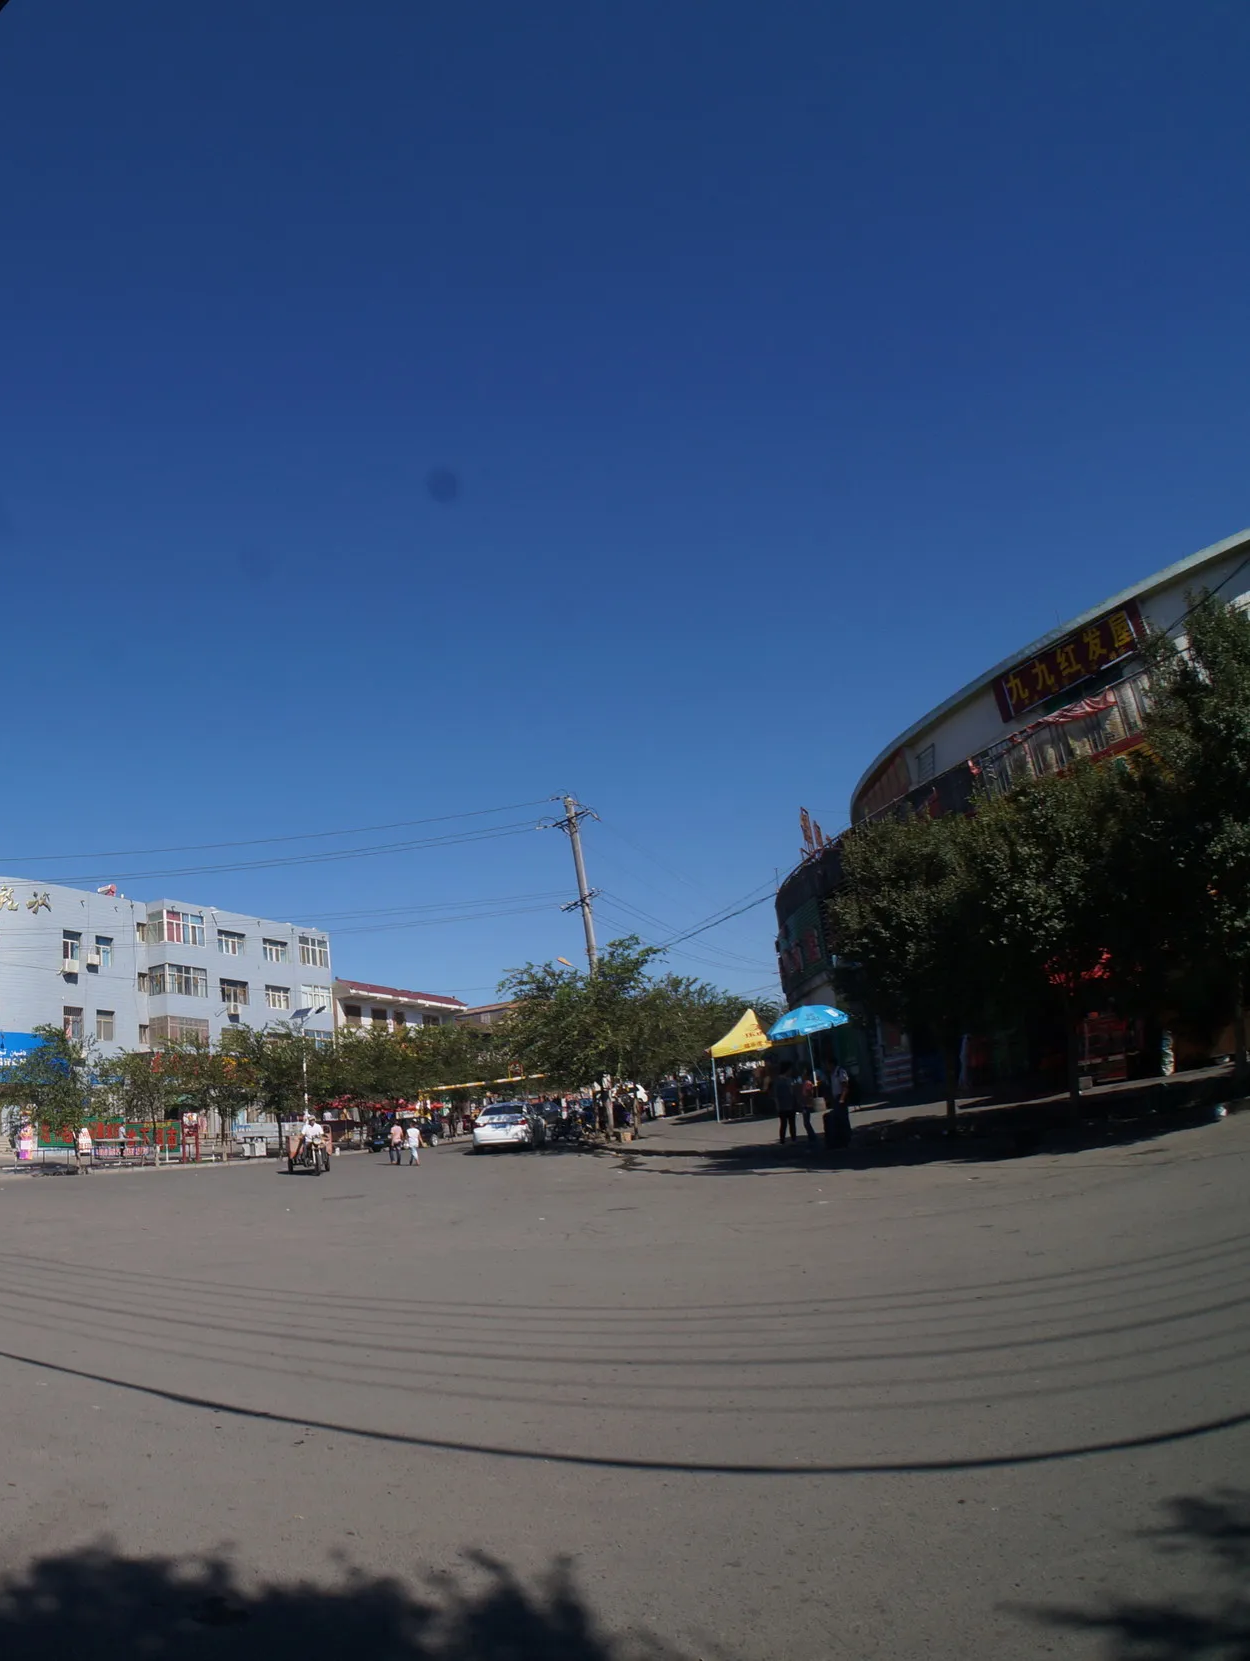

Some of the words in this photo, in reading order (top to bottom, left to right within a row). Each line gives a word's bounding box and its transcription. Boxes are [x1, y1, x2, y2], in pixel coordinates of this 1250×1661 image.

[1006, 610, 1133, 705] 九九红发屋
